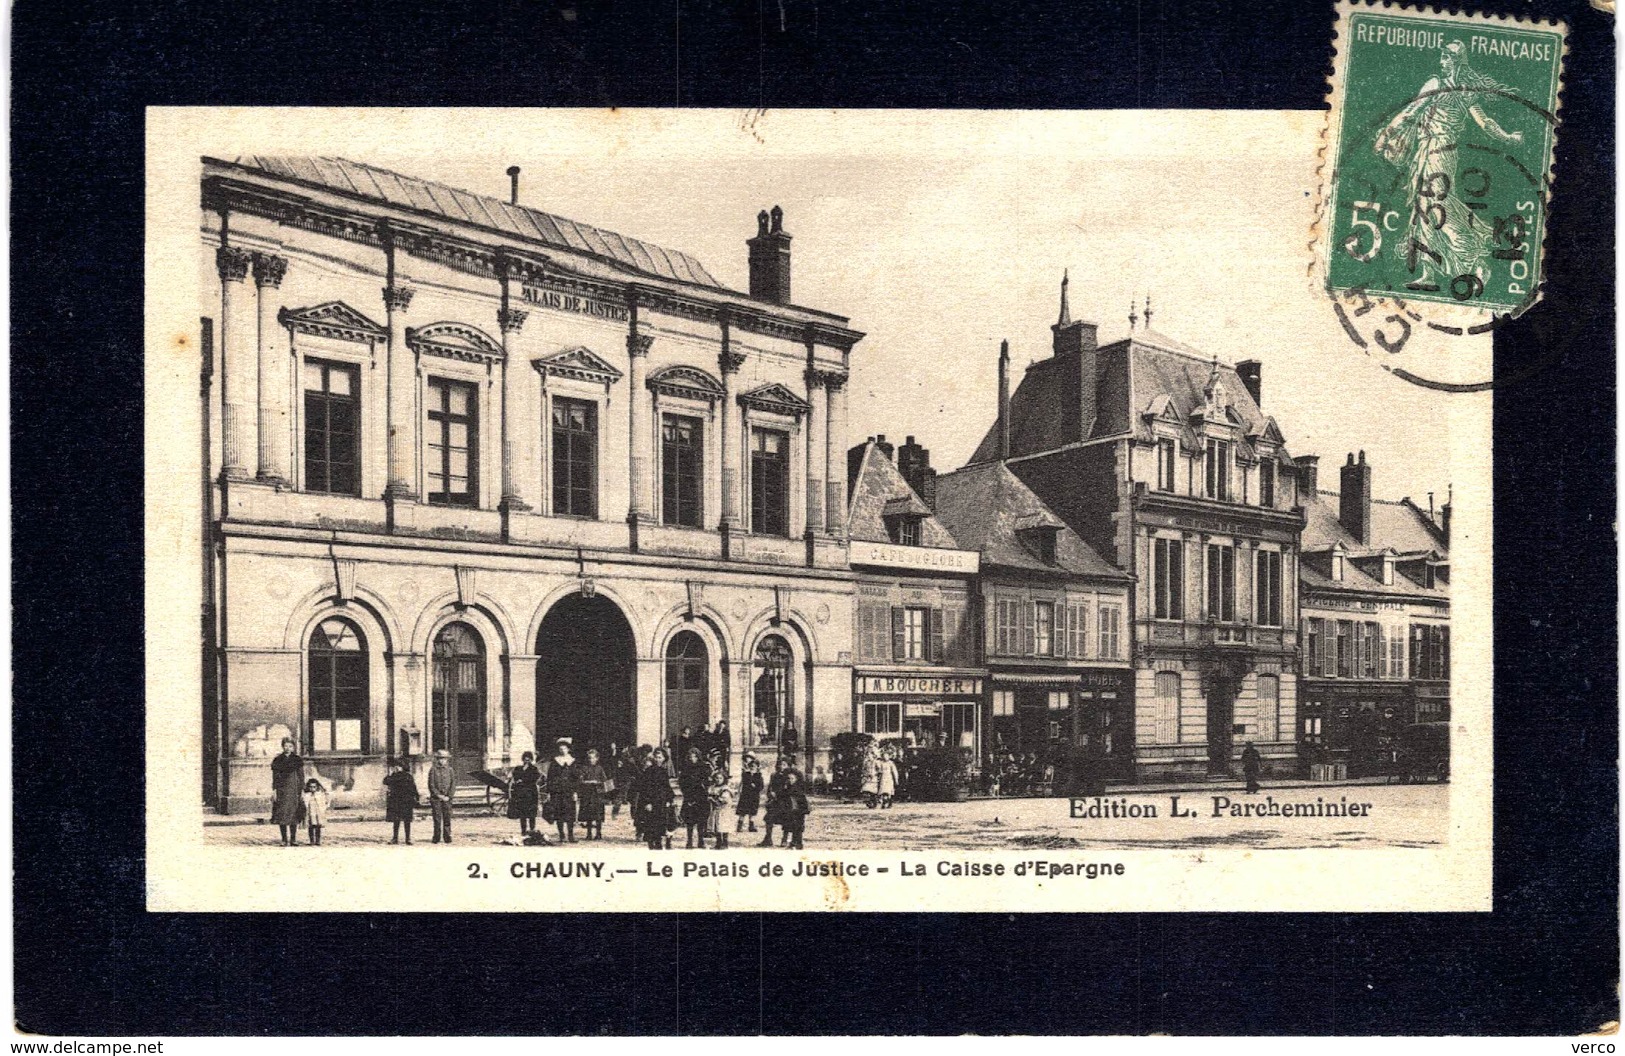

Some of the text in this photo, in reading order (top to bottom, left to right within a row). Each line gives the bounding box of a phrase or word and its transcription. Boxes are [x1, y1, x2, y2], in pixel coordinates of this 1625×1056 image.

[1357, 23, 1551, 62] REPUBLIQUE FRANÇAISE
[564, 296, 580, 312] DE
[583, 300, 629, 322] JUSTICE
[922, 552, 963, 567] GLOBE
[886, 678, 965, 693] BOUCHER
